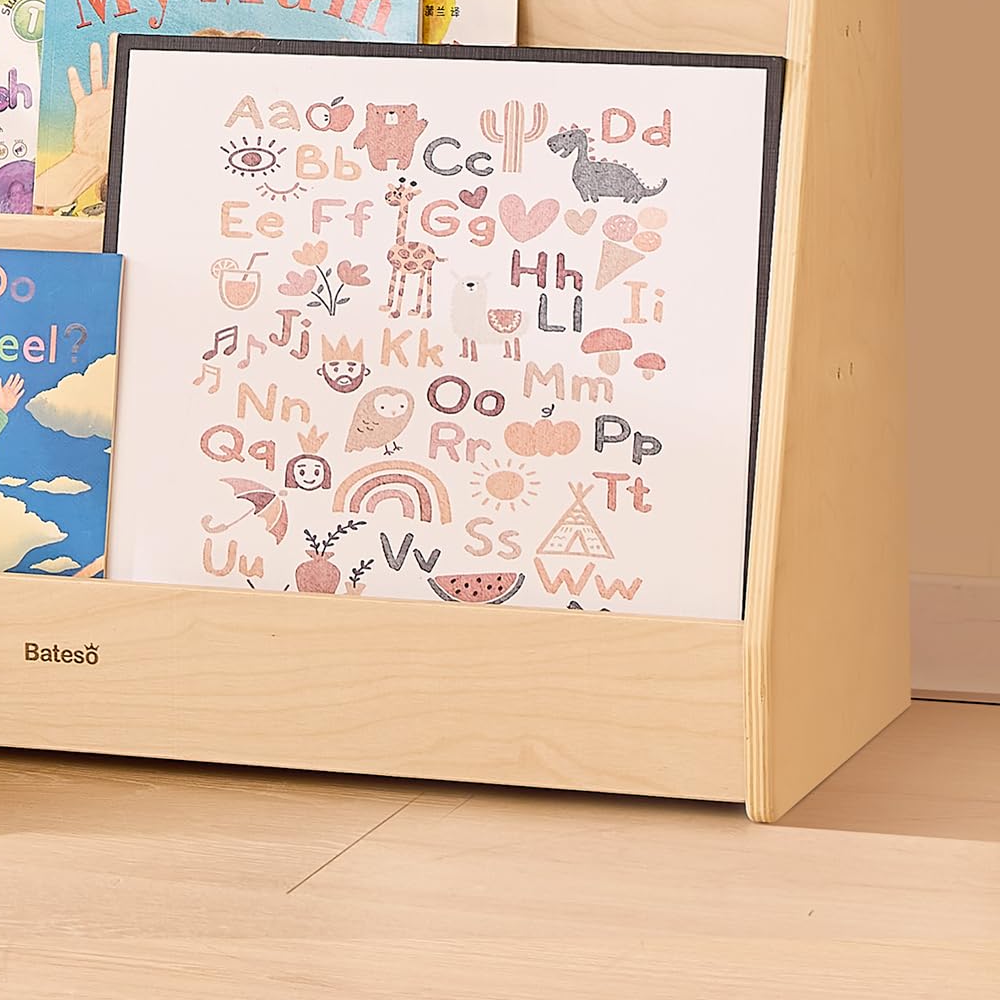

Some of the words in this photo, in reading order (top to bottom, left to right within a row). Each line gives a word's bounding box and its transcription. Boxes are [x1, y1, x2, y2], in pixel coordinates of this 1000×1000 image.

[27, 6, 39, 34] 1
[224, 95, 301, 131] Aa
[602, 107, 671, 147] Dd
[295, 144, 362, 181] Bb
[423, 137, 495, 176] Cc
[220, 201, 285, 239] Ee
[311, 199, 374, 238] Ff
[420, 199, 496, 247] Gg
[511, 249, 584, 292] Hh
[623, 281, 666, 324] Ii
[269, 309, 312, 360] Jj
[381, 328, 444, 368] Kk
[237, 382, 311, 423] Nn
[427, 375, 505, 417] Oo
[523, 361, 614, 403] Mm
[200, 424, 276, 471] Qq
[428, 421, 491, 463] Rr
[594, 414, 662, 465] Pp
[592, 471, 652, 513] Tt
[202, 538, 264, 578] Uu
[379, 532, 441, 573] Vv
[464, 517, 522, 560] Ss
[534, 557, 643, 600] Ww
[24, 642, 99, 665] Bateso
